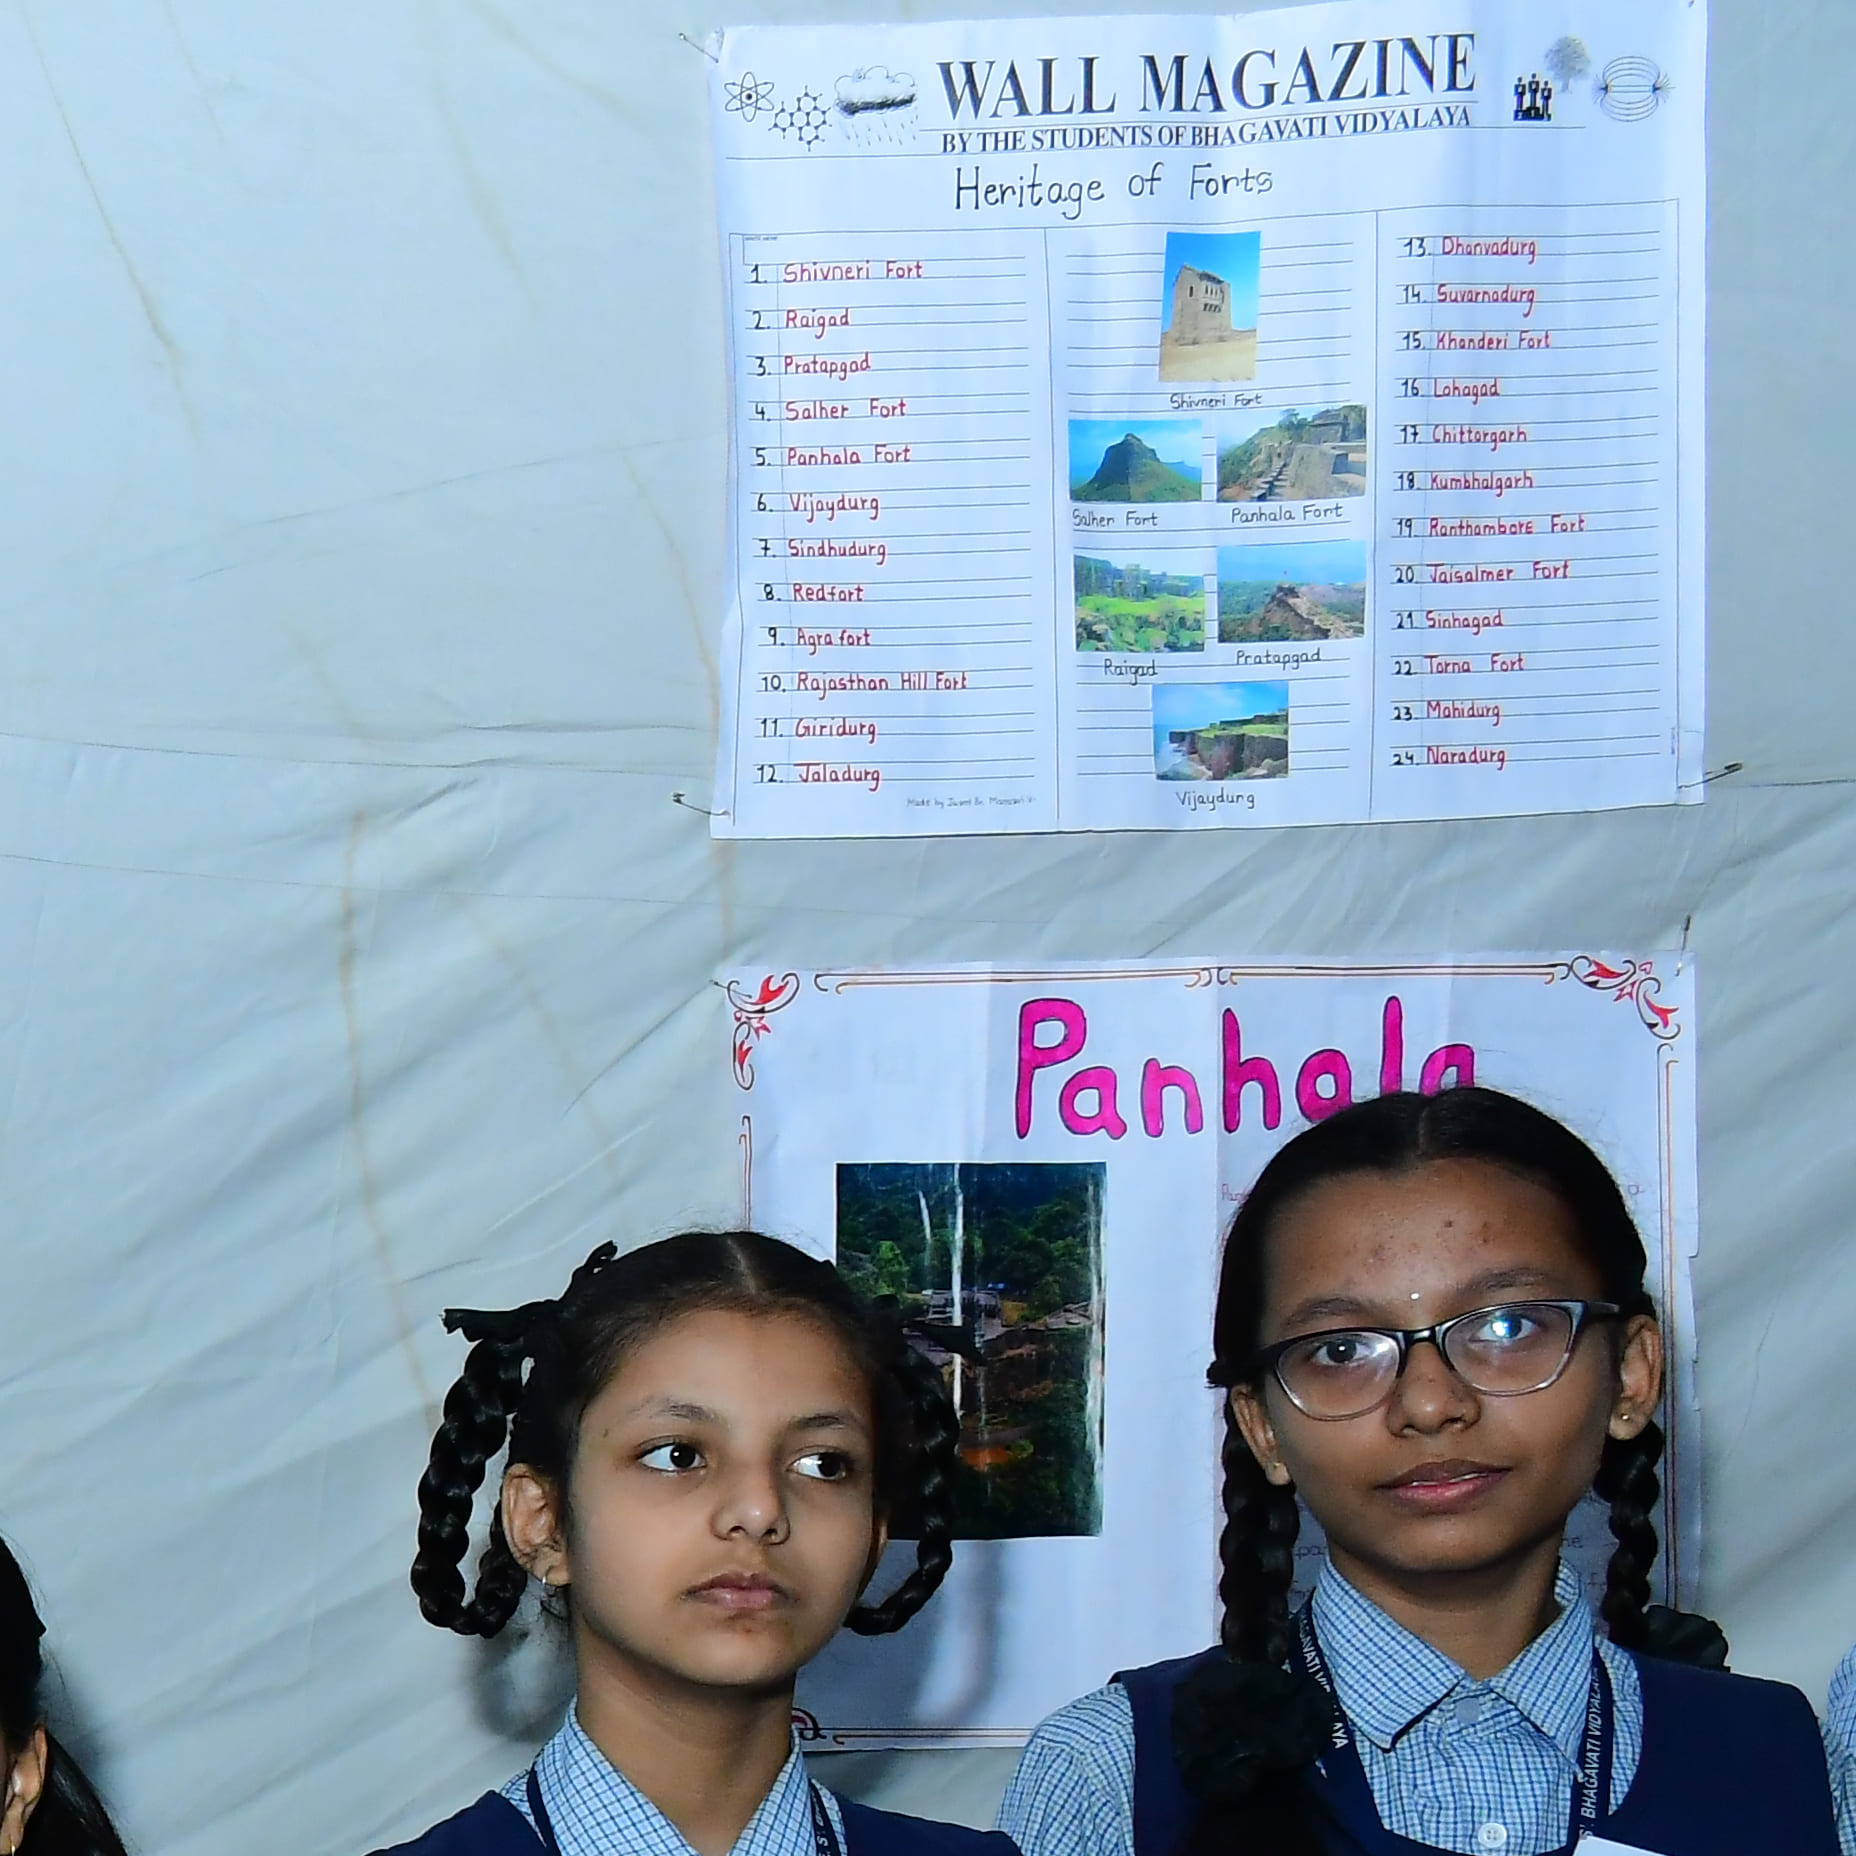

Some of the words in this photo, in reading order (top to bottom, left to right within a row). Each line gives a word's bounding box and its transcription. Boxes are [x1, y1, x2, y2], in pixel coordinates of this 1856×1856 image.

[936, 56, 1119, 120] WALL
[1139, 31, 1476, 113] MAGAZINE
[940, 134, 972, 155] BY
[975, 131, 1026, 153] THE
[1031, 126, 1157, 151] STUDENTS
[1162, 124, 1191, 148] OF
[1191, 115, 1329, 147] BHAGAVATI
[1334, 104, 1472, 135] VIDYALAYA
[955, 164, 1106, 220] Heritage
[1127, 161, 1166, 200] of
[1189, 161, 1274, 200] Forts
[750, 264, 767, 284] 1.
[783, 259, 871, 283] Shivneri
[885, 259, 923, 280] Fort
[752, 310, 770, 330] 2.
[785, 308, 850, 339] Raigad
[756, 356, 772, 376] 3.
[784, 352, 871, 381] Pratapgad
[755, 401, 771, 421] 4.
[785, 400, 849, 421] Salher
[869, 398, 906, 418] Fort
[1169, 393, 1226, 410] Shivneri
[1233, 393, 1262, 407] Fort
[1432, 424, 1528, 452] Chittorgarh
[756, 447, 772, 466] 5.
[787, 447, 861, 466] Panhala
[873, 444, 912, 463] Fort
[789, 493, 880, 522] Vijaydurg
[1426, 746, 1506, 770] Naradurg
[1016, 996, 1475, 1137] Panhala
